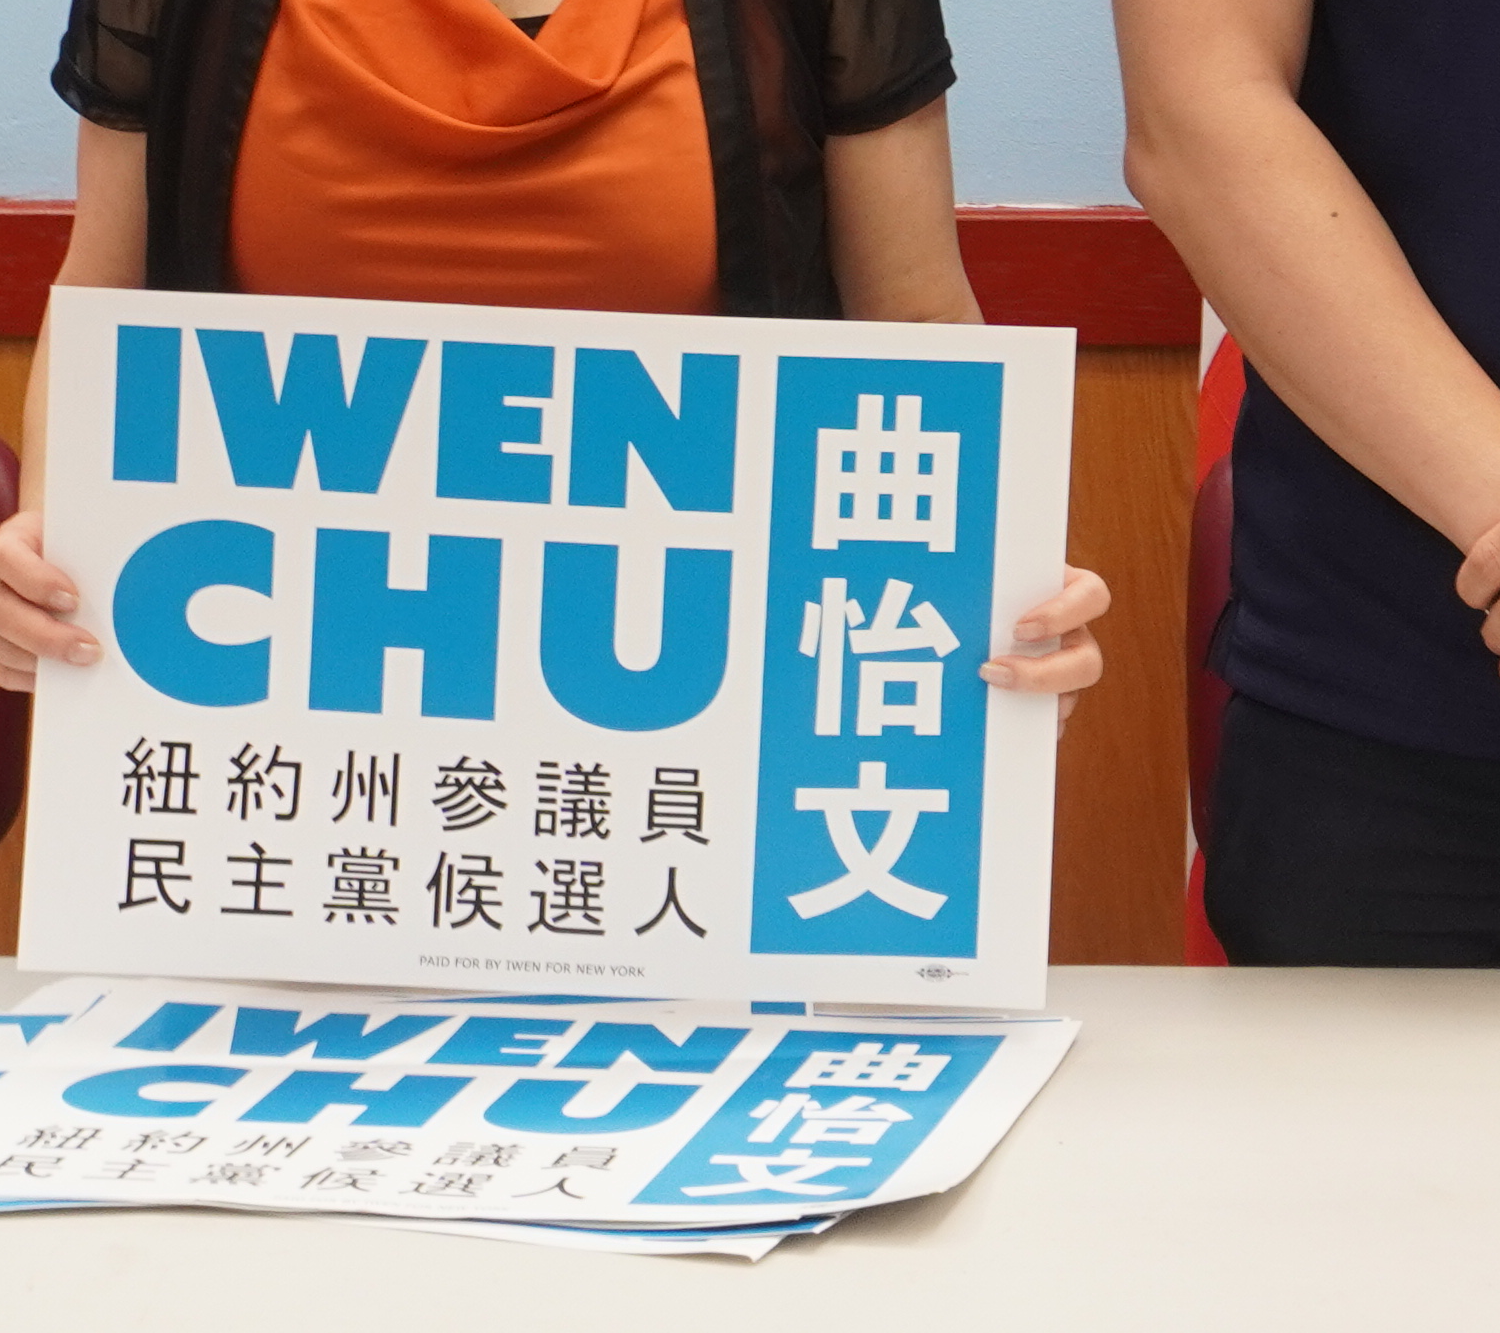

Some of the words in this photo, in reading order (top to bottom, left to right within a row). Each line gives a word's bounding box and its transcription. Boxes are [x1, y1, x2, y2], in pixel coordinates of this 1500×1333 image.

[113, 325, 740, 514] IWEN
[112, 519, 733, 732] CHU
[789, 394, 961, 922] 曲怡文
[120, 736, 710, 847] 紐約州參議員
[117, 838, 708, 938] 民主黨候選人
[419, 955, 450, 968] PAID
[455, 957, 480, 970] FOR
[485, 960, 501, 971] BY
[506, 960, 541, 973] IWEN
[546, 962, 571, 974] FOR
[576, 964, 605, 976] NEW
[611, 965, 646, 978] YORK
[113, 1000, 753, 1074] IWEN
[16, 1125, 619, 1171] 紐約州參議員
[62, 1064, 704, 1135] CHU
[681, 1042, 952, 1197] 曲怡文
